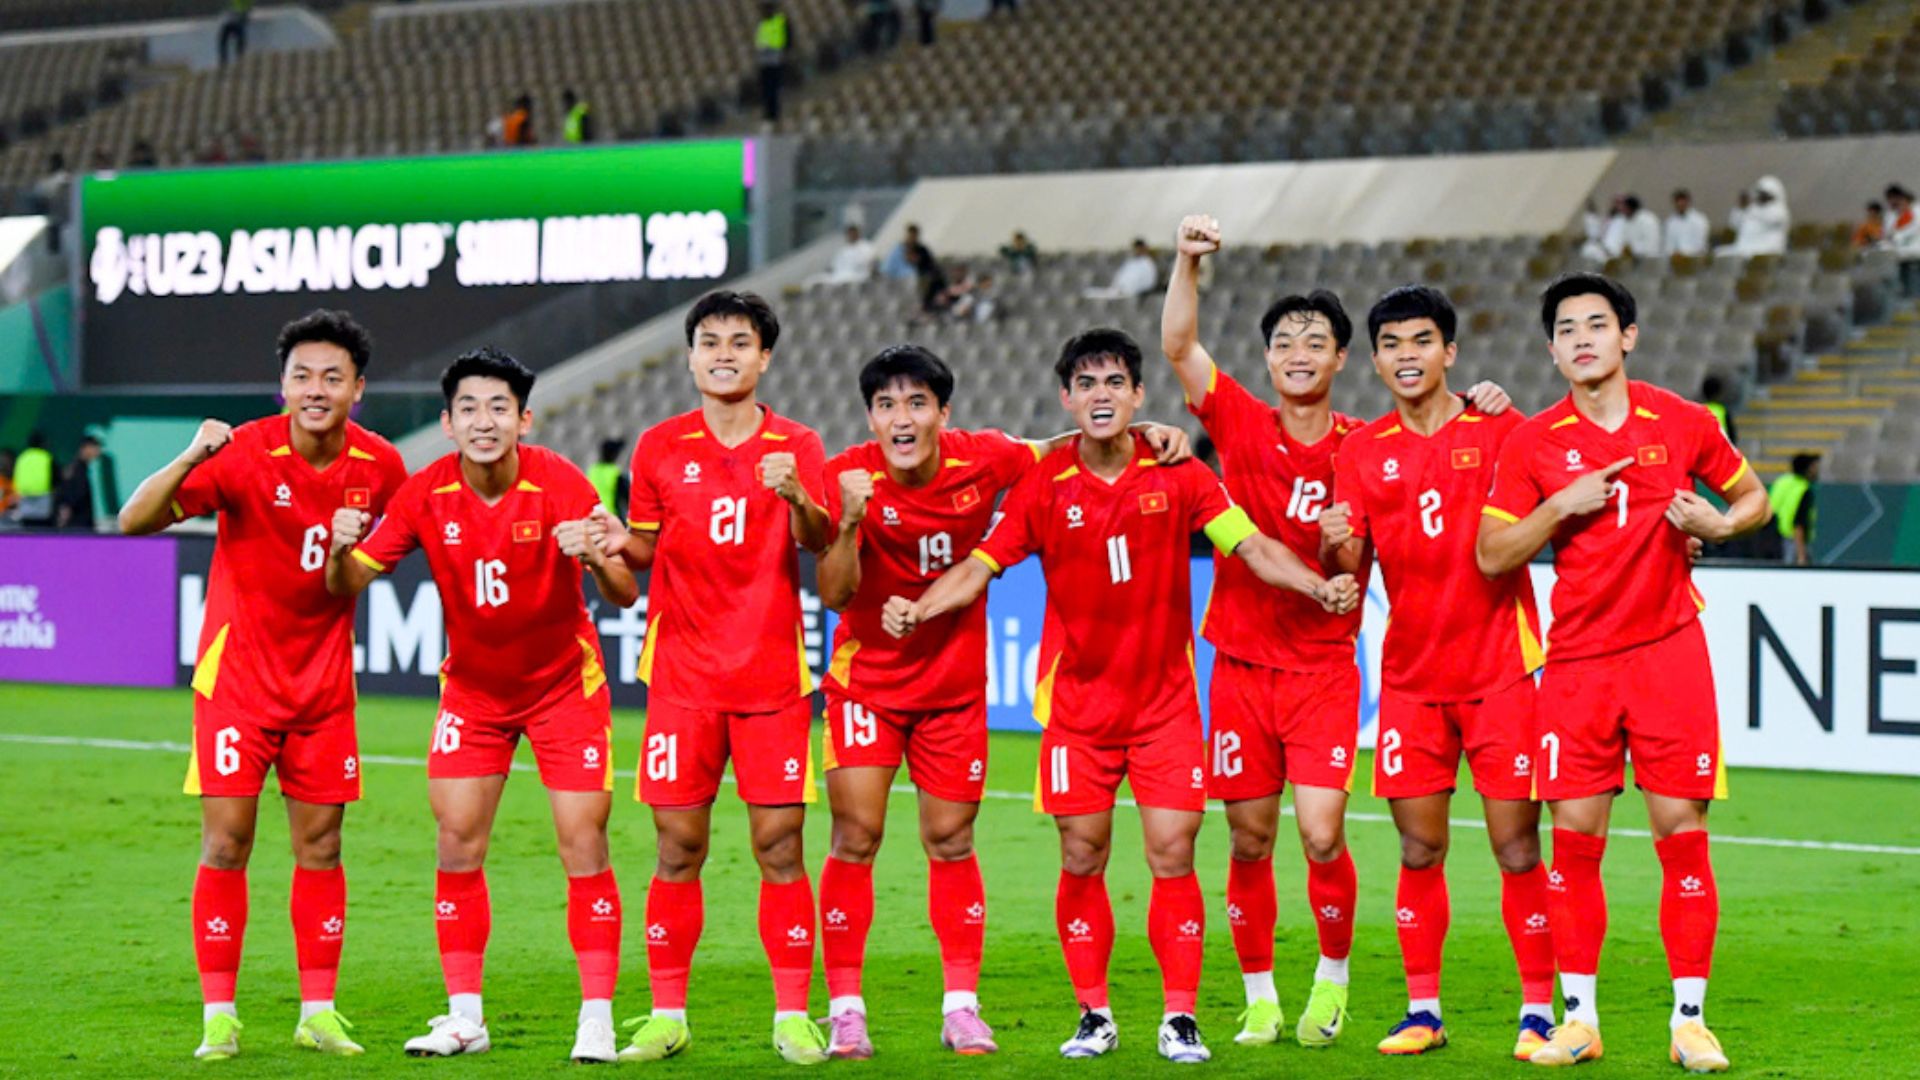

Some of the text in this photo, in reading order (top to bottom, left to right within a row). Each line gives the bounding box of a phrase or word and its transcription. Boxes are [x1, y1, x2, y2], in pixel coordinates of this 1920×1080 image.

[145, 230, 223, 296] U23
[222, 225, 352, 293] ASIAN
[351, 222, 446, 290] CUP
[709, 496, 747, 545] 21
[1286, 476, 1327, 523] 12
[1418, 488, 1444, 538] 2
[300, 523, 328, 572] 6
[919, 531, 952, 576] 19
[1107, 534, 1132, 585] 11
[475, 558, 510, 608] 16
[432, 710, 465, 754] 16
[843, 700, 877, 748] 19
[215, 726, 241, 776] 6
[647, 732, 678, 782] 21
[1051, 745, 1070, 794] 11
[1213, 729, 1243, 778] 12
[1383, 728, 1403, 777] 2
[1541, 731, 1560, 781] 7
